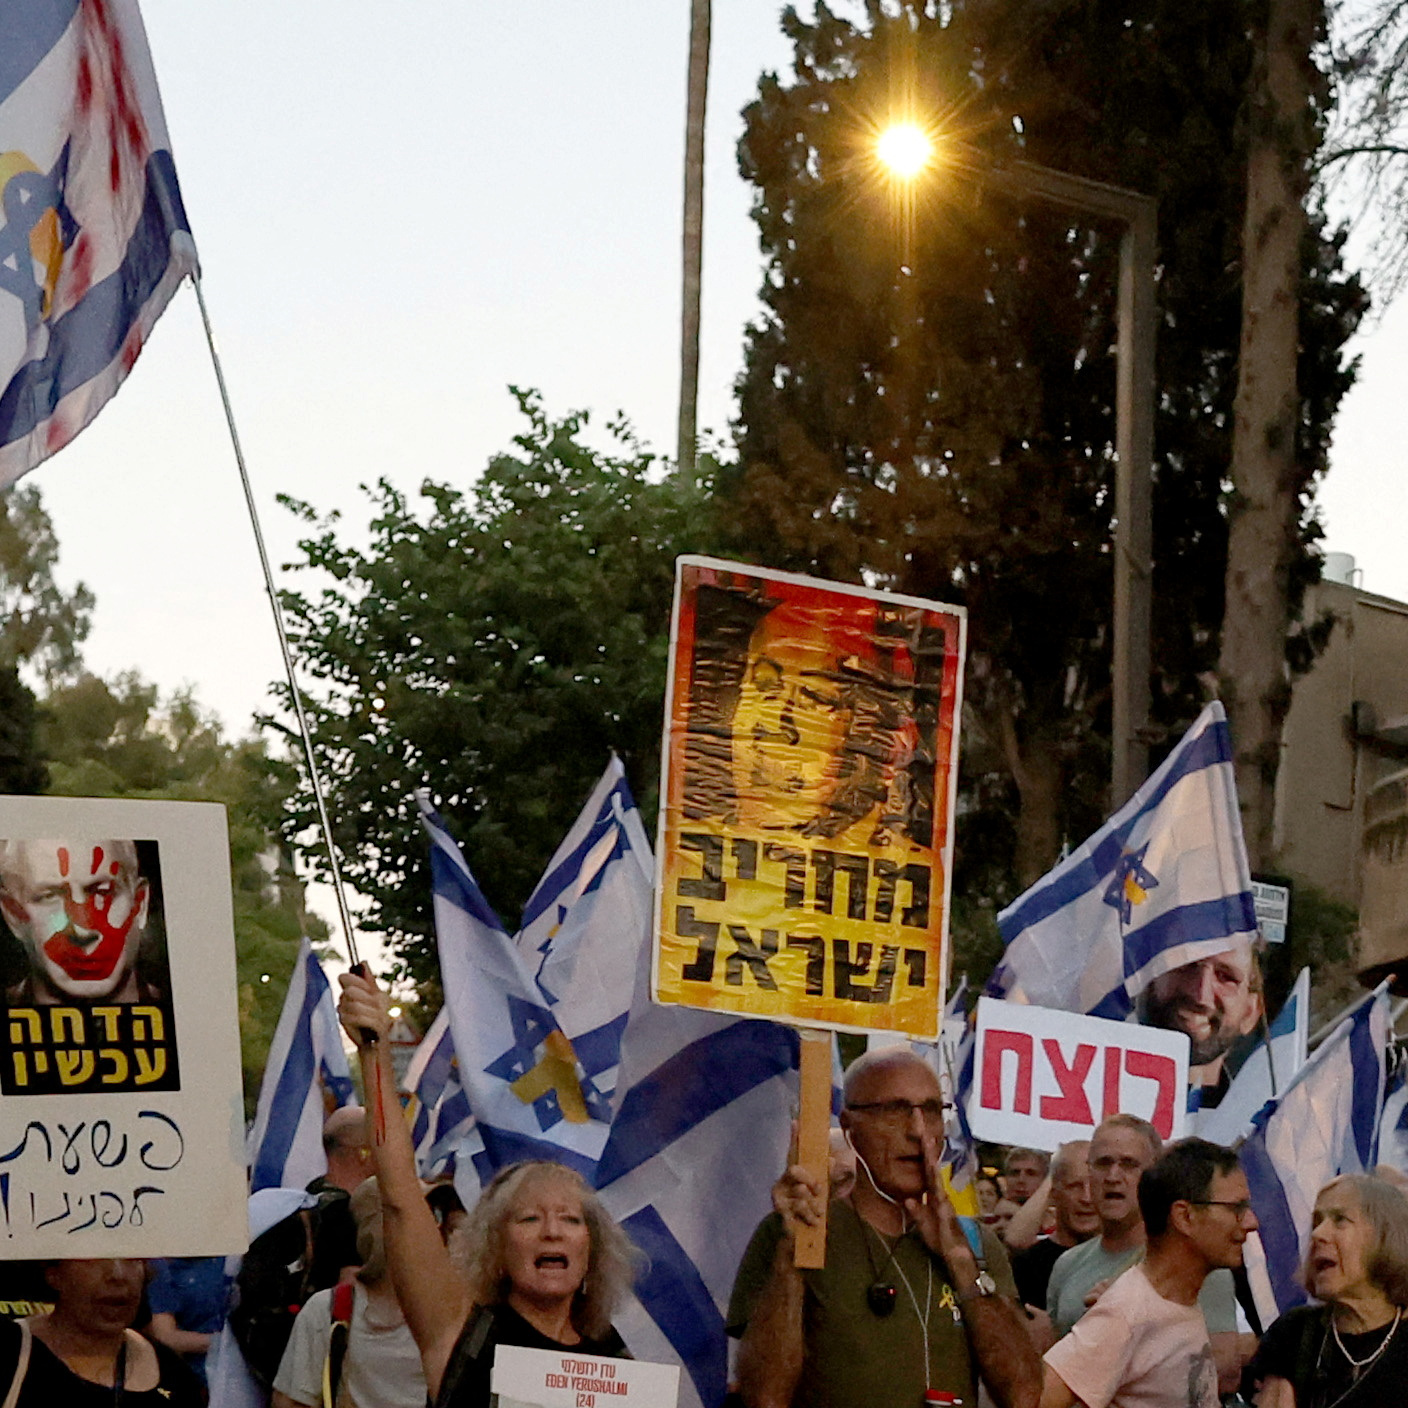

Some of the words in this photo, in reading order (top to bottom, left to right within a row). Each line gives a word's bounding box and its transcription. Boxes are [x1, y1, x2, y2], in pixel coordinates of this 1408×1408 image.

[677, 832, 930, 929] מחריב
[676, 905, 926, 1003] ישראל
[8, 1006, 165, 1045] הדחה
[12, 1047, 167, 1086] עכשיו
[980, 1029, 1176, 1140] רוצח
[545, 1373, 569, 1389] EDEN
[572, 1376, 628, 1395] YERUSHALMI
[575, 1392, 595, 1408] (24)
